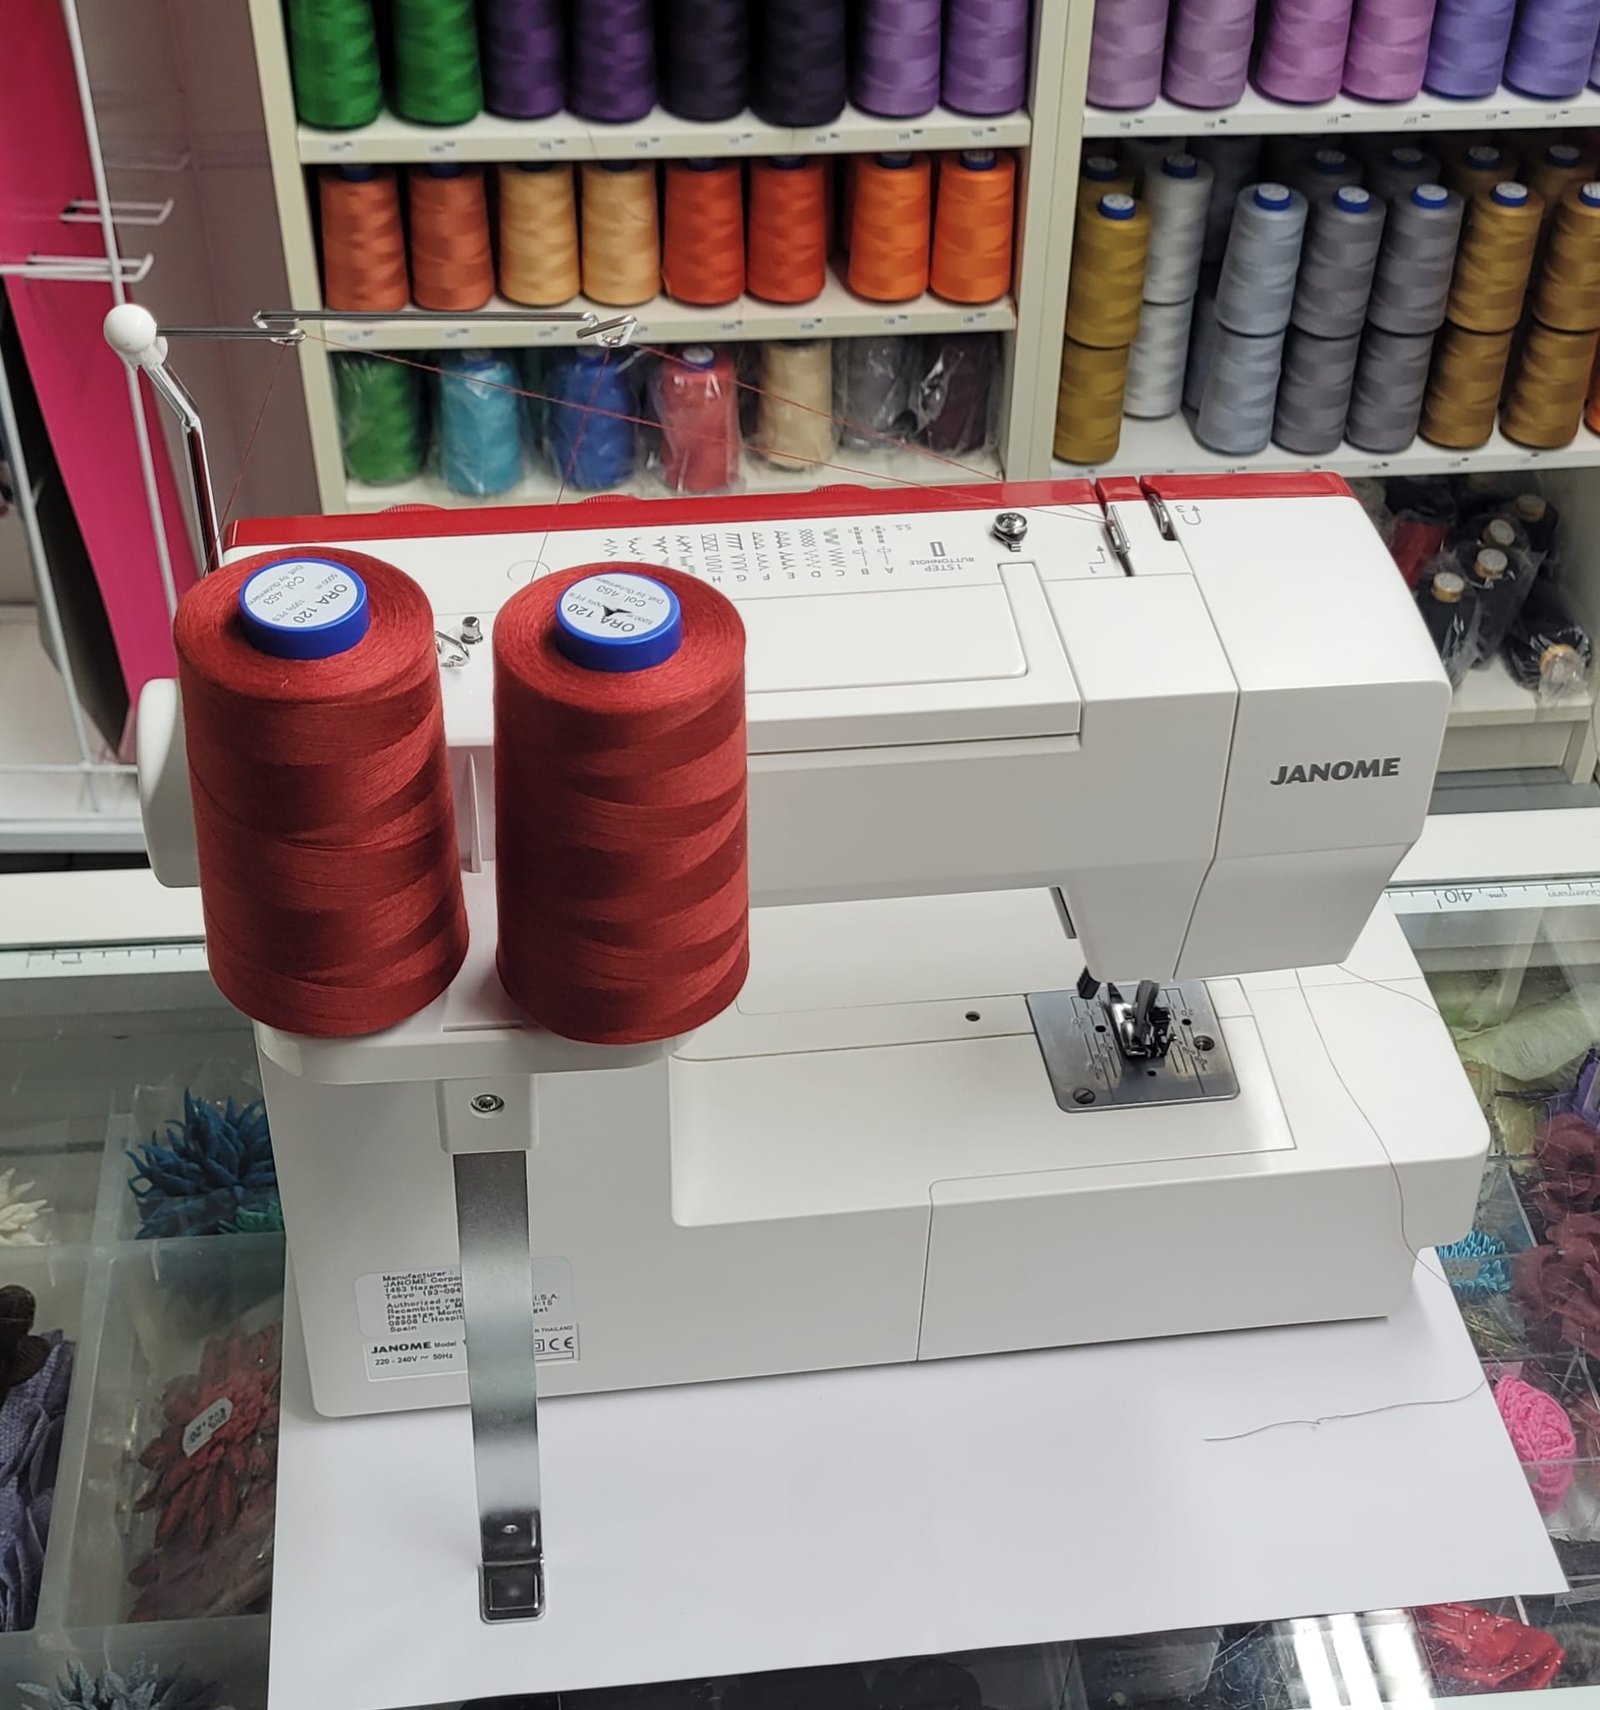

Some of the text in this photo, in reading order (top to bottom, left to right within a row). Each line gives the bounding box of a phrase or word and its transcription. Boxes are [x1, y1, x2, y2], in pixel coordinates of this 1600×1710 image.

[909, 556, 975, 565] BUTTONHOLE
[835, 569, 845, 577] C
[924, 564, 954, 572] STEP
[712, 575, 721, 583] H
[763, 573, 770, 581] F
[282, 576, 305, 590] Col.
[293, 584, 348, 624] ORA 120
[567, 603, 635, 632] ORA 120
[1269, 757, 1401, 785] JANOME
[382, 1271, 447, 1282] Manufacturer
[384, 1279, 427, 1288] JANOME
[386, 1298, 441, 1309] Authorized
[388, 1304, 440, 1314] Recambios
[389, 1325, 417, 1333] Spain
[371, 1340, 457, 1354] JANOME Model
[397, 1355, 418, 1364] 240V
[433, 1353, 454, 1361] 50Hz
